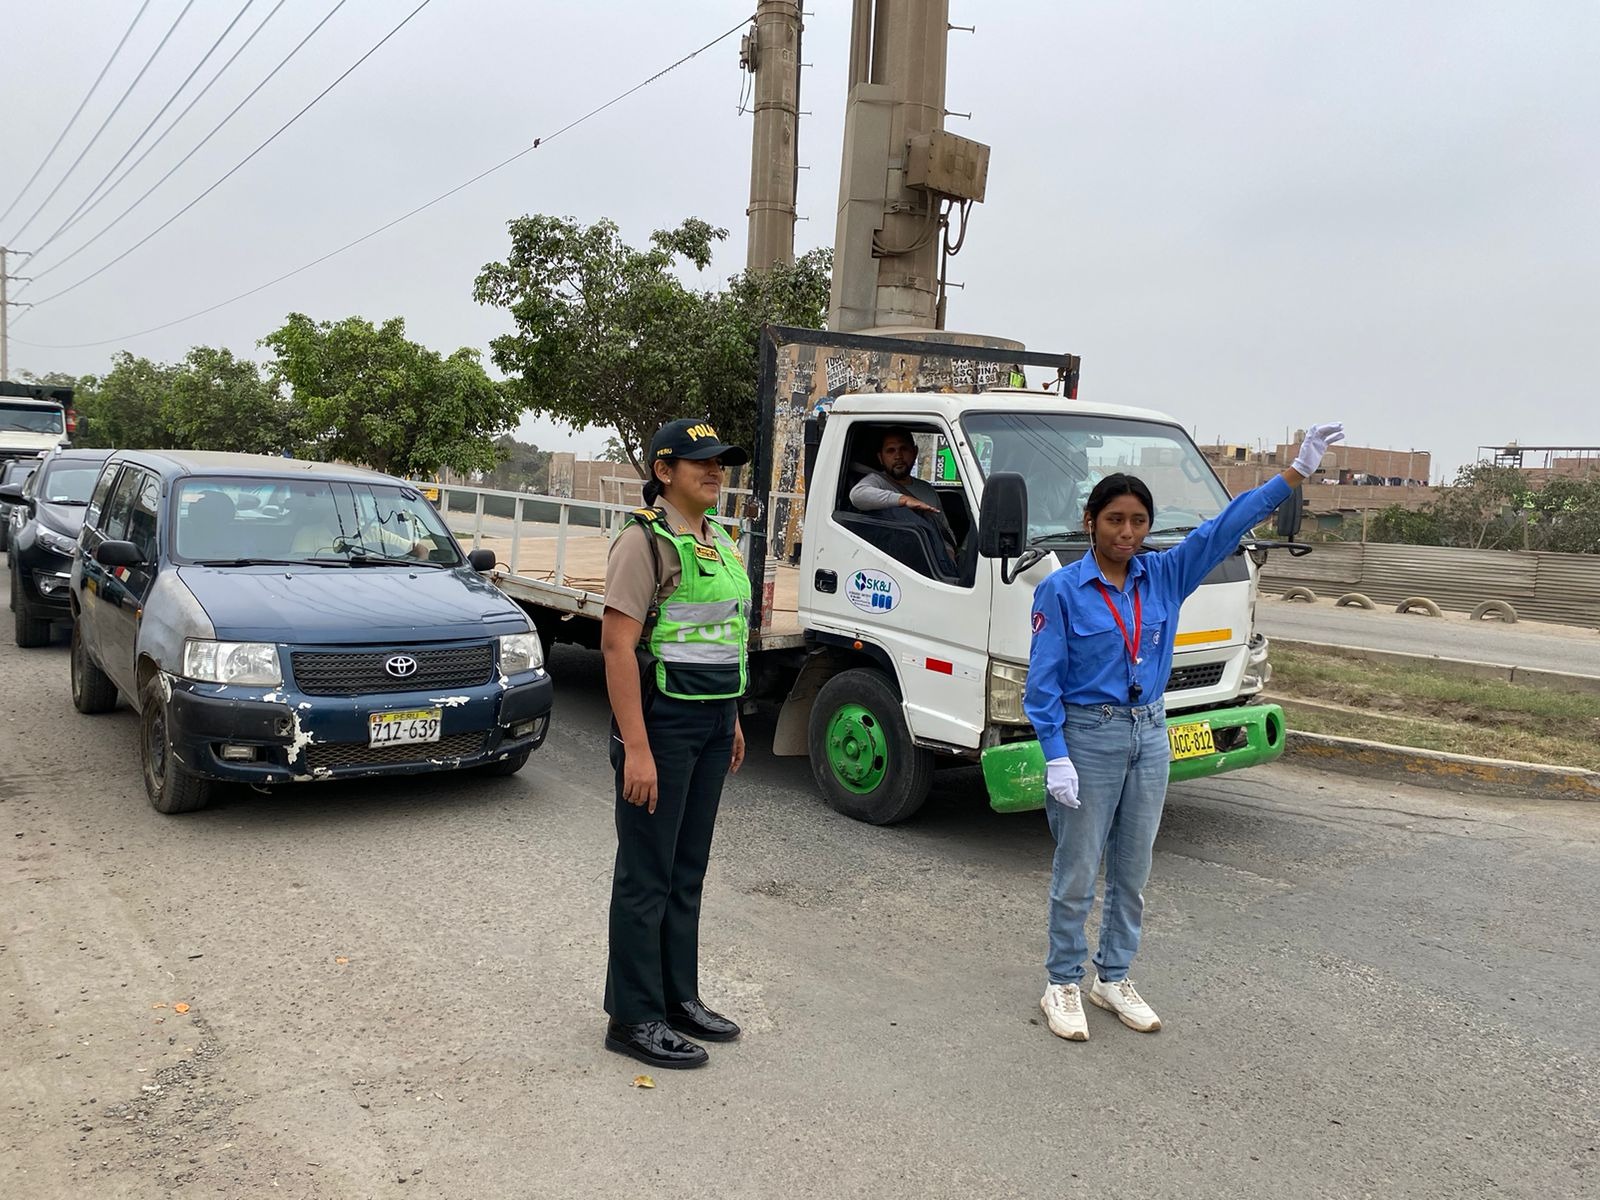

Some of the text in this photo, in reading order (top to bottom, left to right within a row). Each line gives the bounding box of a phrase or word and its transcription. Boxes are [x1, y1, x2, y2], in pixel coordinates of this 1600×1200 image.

[866, 578, 891, 592] SK&J
[393, 713, 419, 721] PERU
[1174, 731, 1212, 754] ACC-812
